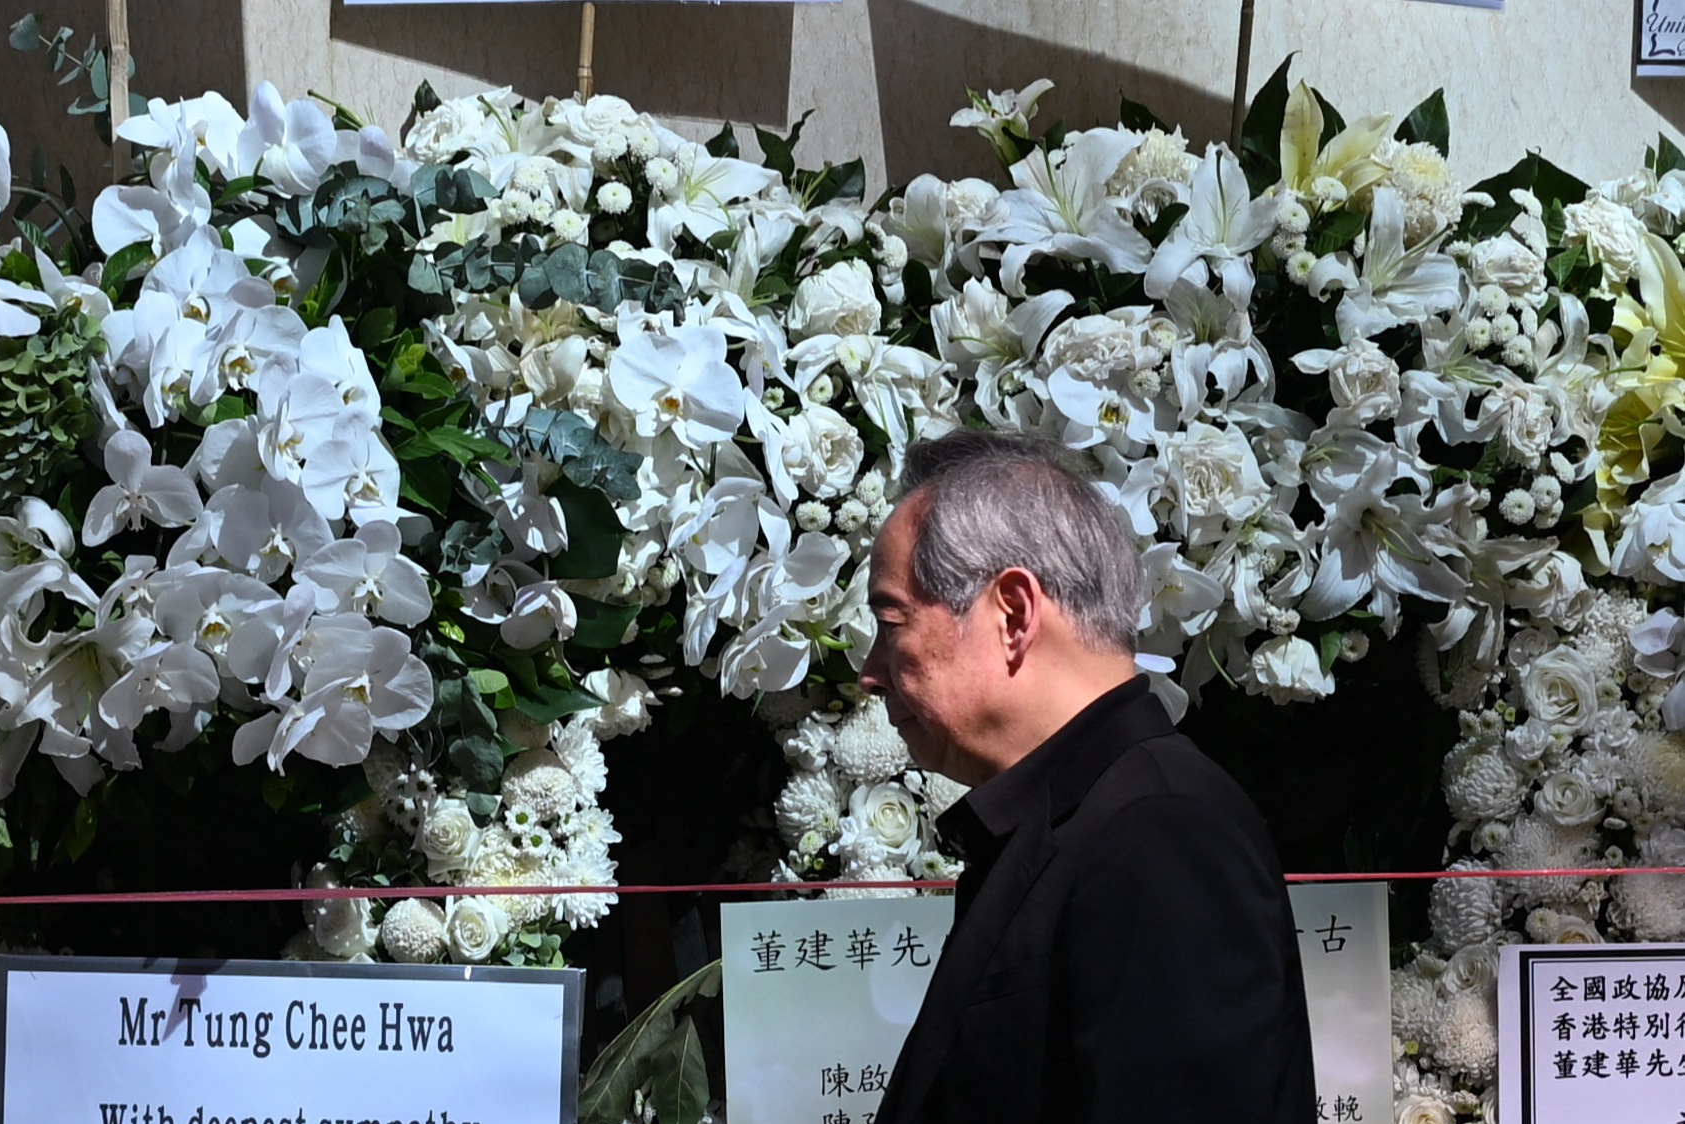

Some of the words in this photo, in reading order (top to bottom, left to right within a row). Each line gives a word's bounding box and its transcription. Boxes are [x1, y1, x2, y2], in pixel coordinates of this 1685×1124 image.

[1647, 12, 1685, 33] Uni
[750, 925, 950, 973] 董建華先
[1295, 914, 1353, 954] 古
[118, 997, 165, 1046] Mr
[178, 997, 273, 1058] Tung
[285, 1000, 366, 1051] Chee
[378, 1002, 454, 1053] Hwa
